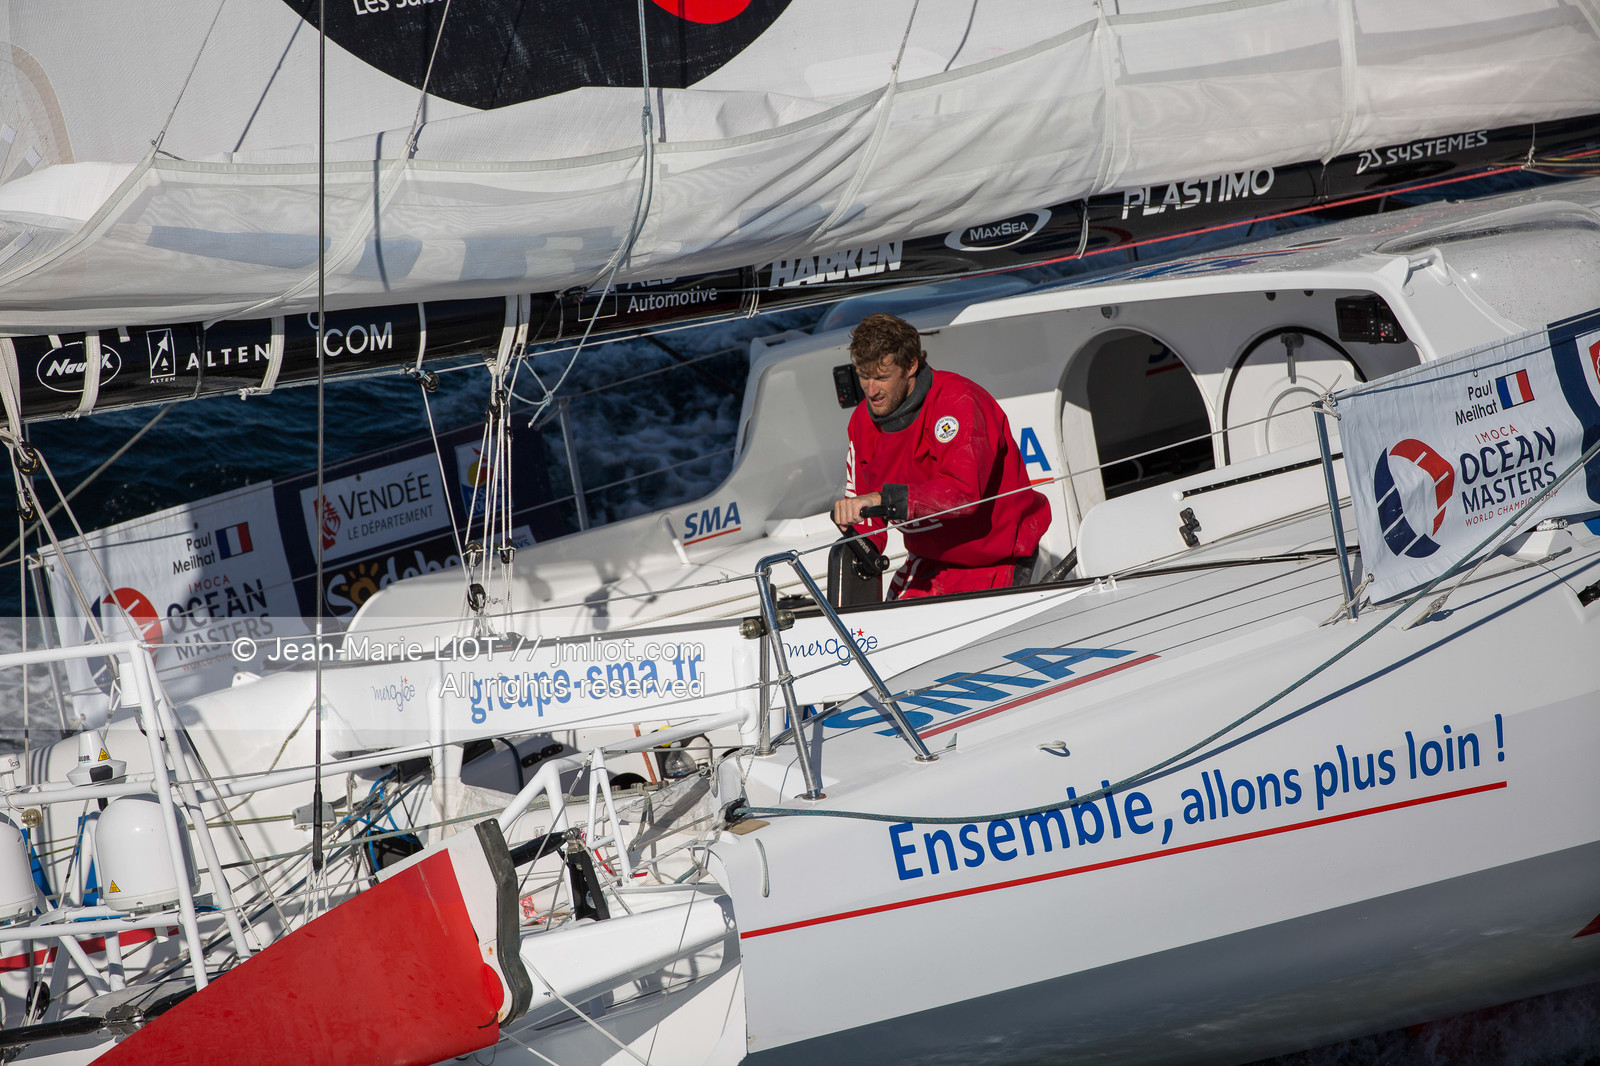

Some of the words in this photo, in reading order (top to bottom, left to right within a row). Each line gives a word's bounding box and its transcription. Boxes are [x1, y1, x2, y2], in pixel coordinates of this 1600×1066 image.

[1386, 130, 1488, 165] SYSTEMES
[1121, 167, 1275, 220] PLASTIMO
[768, 240, 903, 291] HARKEN
[627, 285, 718, 313] Automotive
[186, 343, 270, 371] ALTEN
[150, 376, 176, 384] ALTEN
[1467, 380, 1493, 401] Paul
[1455, 399, 1499, 426] Meilhat
[1475, 424, 1519, 445] IMOCA
[1460, 426, 1556, 485] OCEAN
[338, 471, 433, 521] VENDÉE
[1461, 461, 1557, 515] MASTERS
[347, 526, 360, 541] LE
[361, 504, 435, 537] DÉPARTEMENT
[684, 502, 741, 540] SMA
[1465, 511, 1494, 527] WORLD
[186, 532, 212, 551] Paul
[172, 550, 216, 575] Meilhat
[188, 574, 231, 594] IMOCA
[166, 578, 268, 634] OCEAN
[173, 612, 274, 661] MASTERS
[823, 648, 1138, 738] SMA
[889, 779, 1174, 881] Ensemble,
[1180, 768, 1301, 825] allons
[1314, 744, 1396, 810] plus
[1405, 724, 1482, 780] loin
